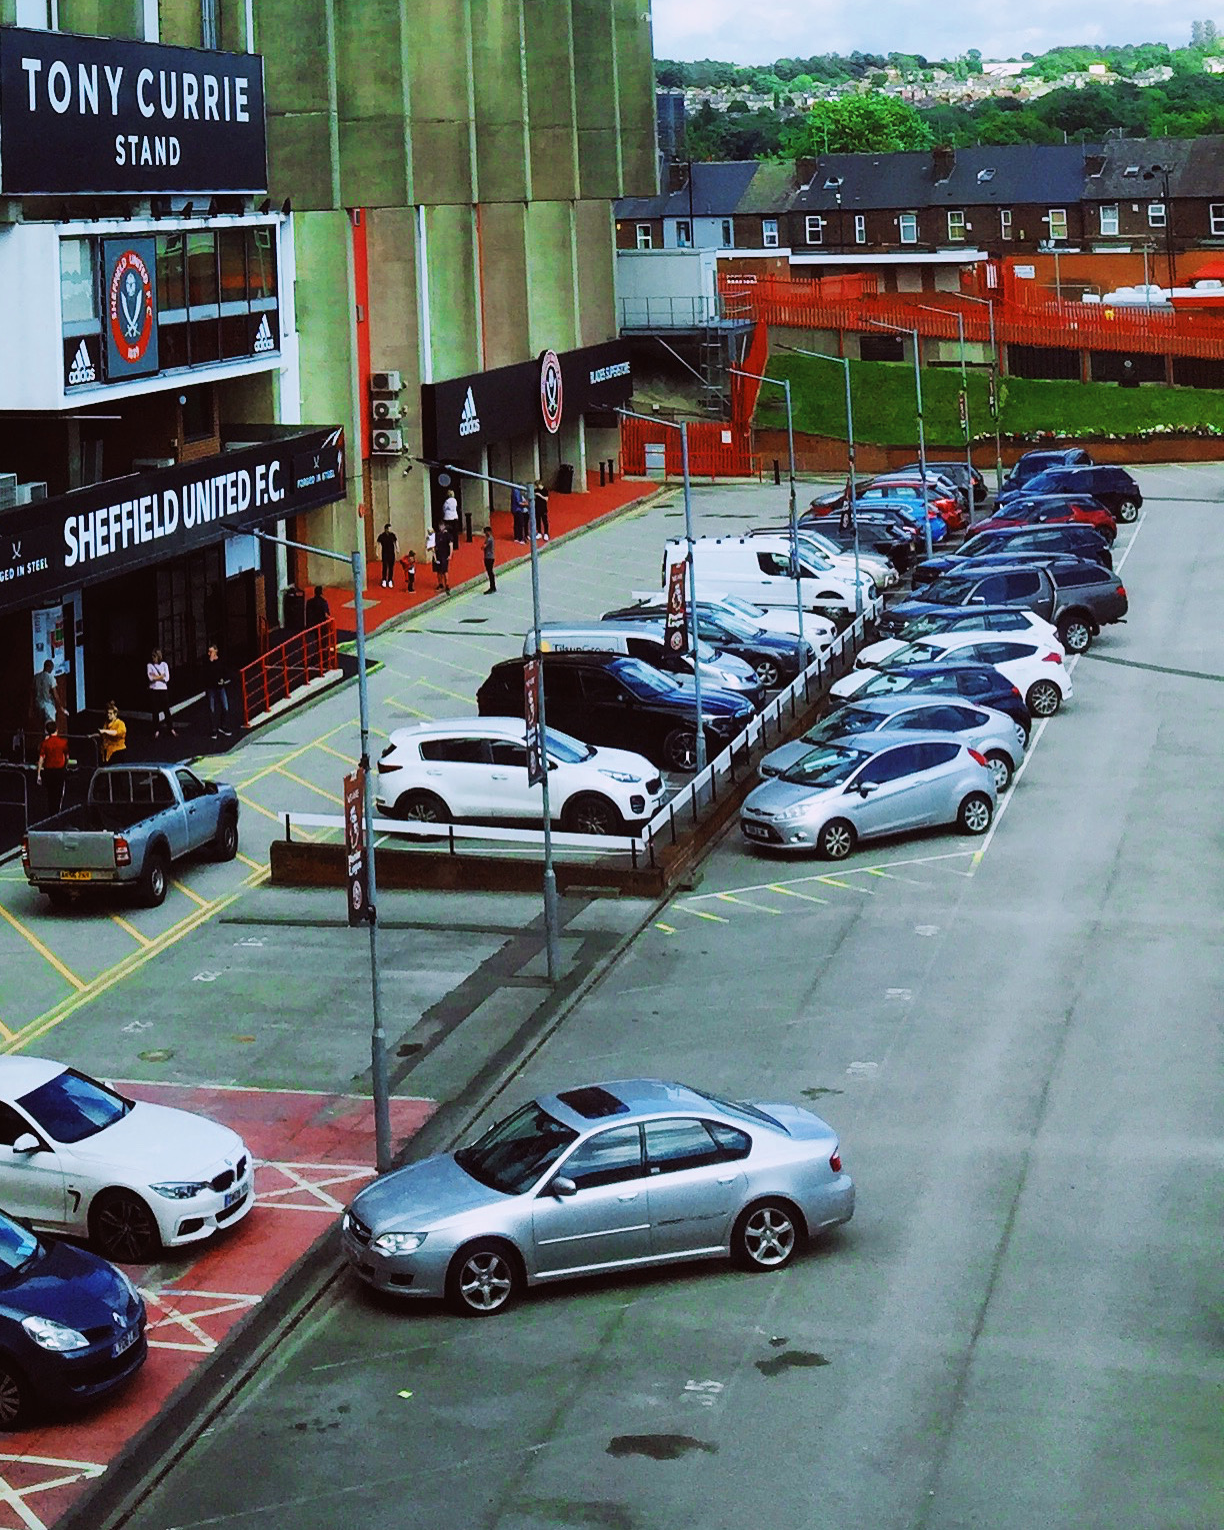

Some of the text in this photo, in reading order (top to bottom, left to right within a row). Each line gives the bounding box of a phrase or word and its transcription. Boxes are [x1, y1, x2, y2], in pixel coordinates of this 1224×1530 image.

[21, 57, 250, 123] TONY CURRIE
[115, 134, 181, 166] STAND
[254, 337, 275, 352] adidas
[68, 367, 96, 385] adidas
[459, 419, 481, 437] adidas
[63, 460, 285, 567] SHEFFIELD UNITED F.C.
[16, 564, 25, 577] IN
[27, 557, 49, 574] STEEL
